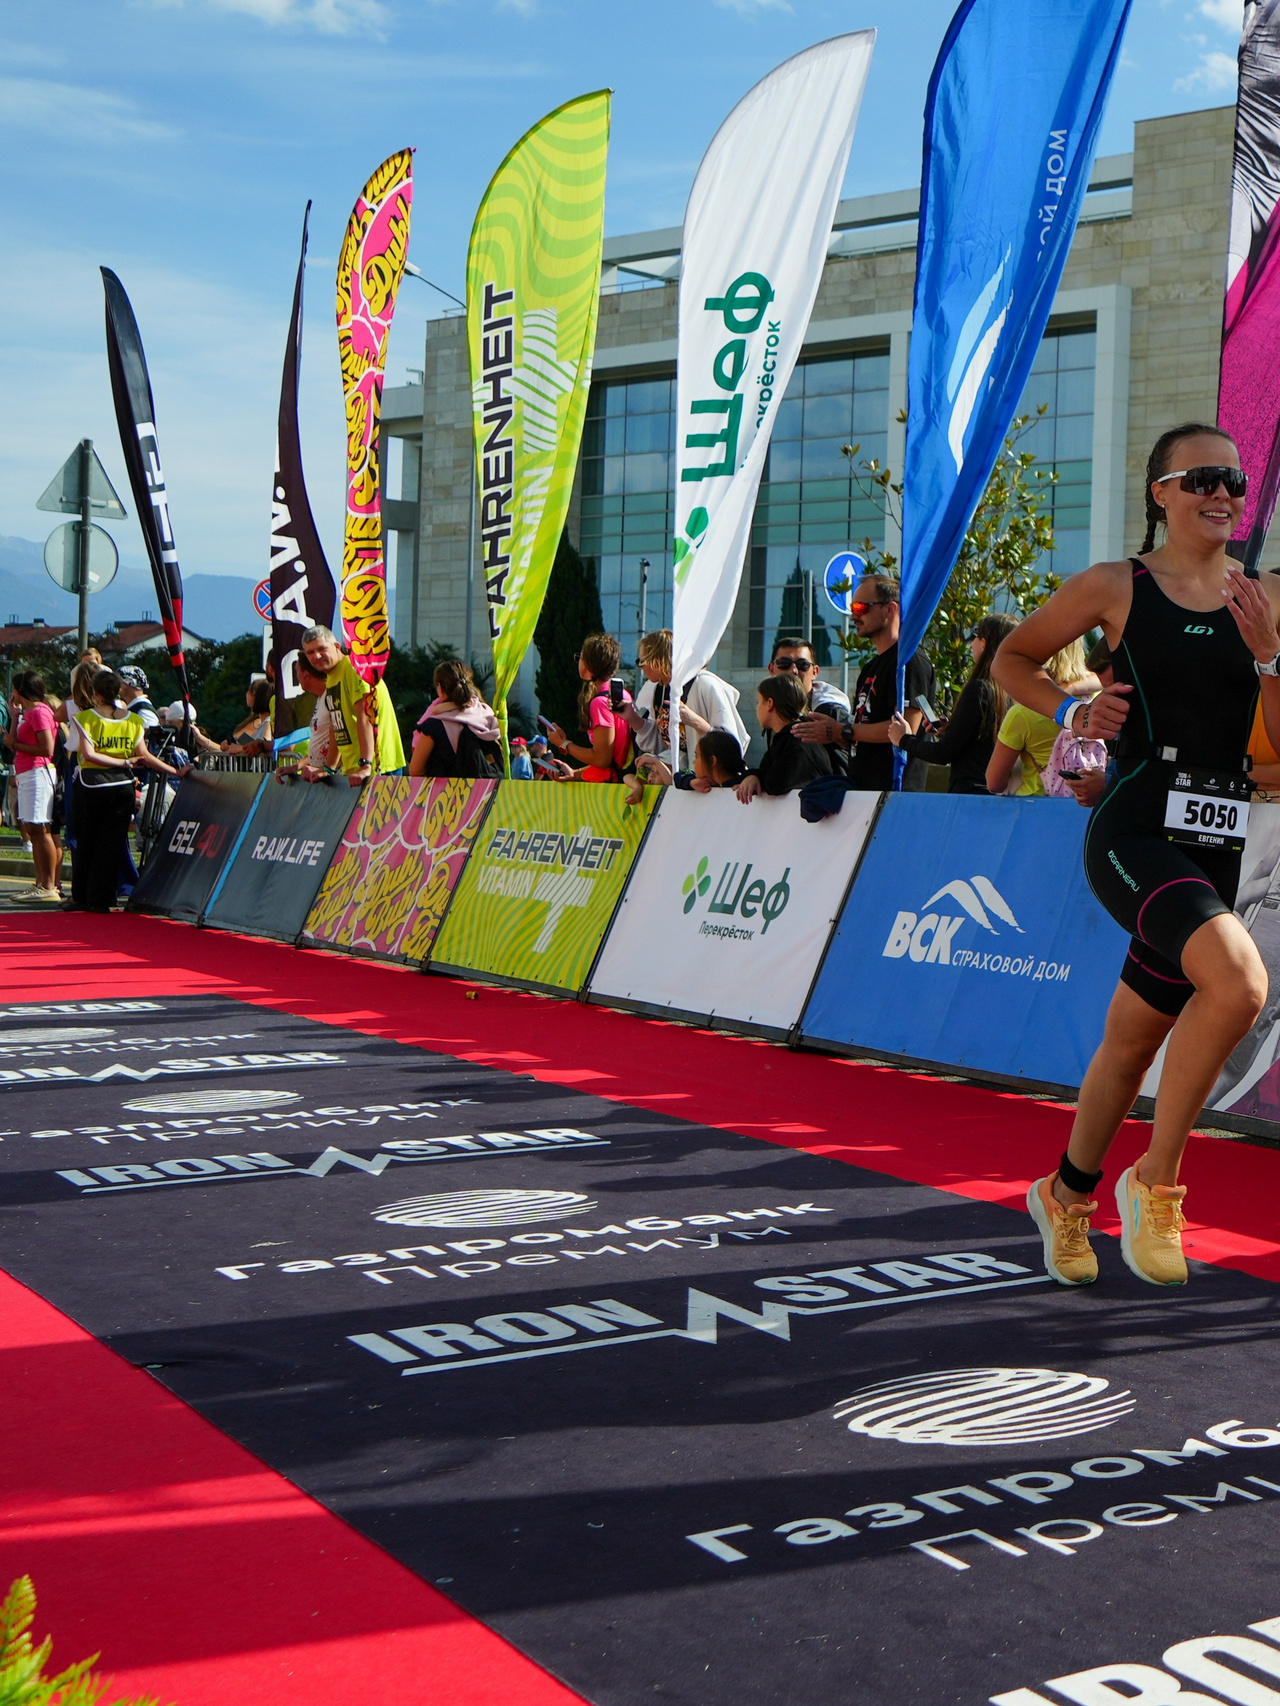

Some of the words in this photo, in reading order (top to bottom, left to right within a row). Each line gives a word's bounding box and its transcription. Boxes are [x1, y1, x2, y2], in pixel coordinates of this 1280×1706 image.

[1175, 778, 1191, 787] STAR
[1184, 800, 1238, 831] 5050
[486, 828, 624, 872] FAHRENHEIT
[477, 865, 537, 899] VITAMIN
[708, 861, 790, 935] Шеф
[699, 920, 756, 941] Перекрёсток
[882, 910, 966, 966] ВСК
[952, 949, 1034, 977] СТРАХОВОЙ
[1032, 962, 1071, 982] ДОМ
[8, 1001, 162, 1014] STAR
[158, 1051, 342, 1070] STAR
[90, 1110, 439, 1145] Премиум
[55, 1151, 296, 1187] IRON
[380, 1127, 603, 1157] STAR
[214, 1201, 836, 1281] Газпромбанк
[361, 1226, 793, 1285] Премиум
[346, 1298, 665, 1365] IRON
[753, 1251, 1041, 1304] STAR
